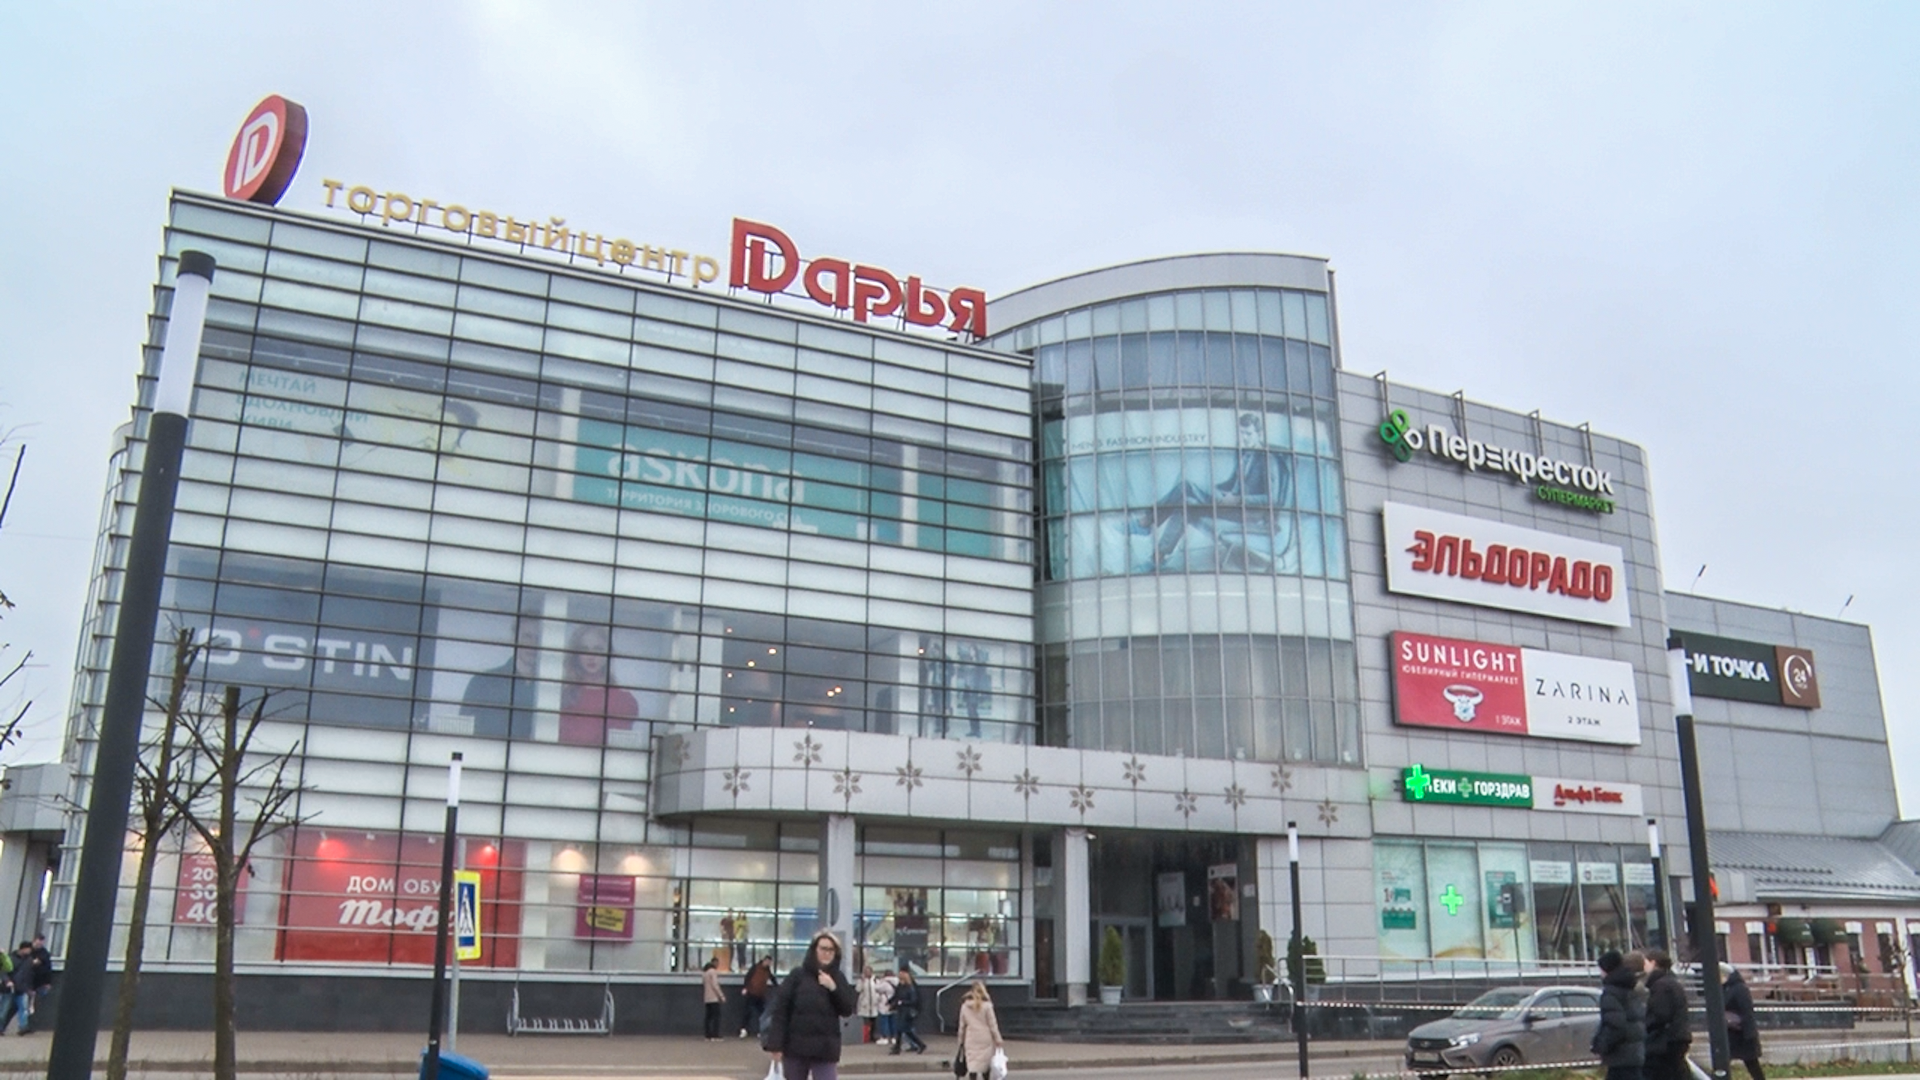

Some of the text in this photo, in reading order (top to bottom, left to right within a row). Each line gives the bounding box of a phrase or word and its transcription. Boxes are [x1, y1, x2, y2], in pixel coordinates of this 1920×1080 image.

[606, 442, 806, 504] askona
[1427, 424, 1614, 494] Перекресток
[1405, 530, 1613, 602] ЭЛЬДОРАДО
[1401, 639, 1517, 673] SUNLIGHT
[1710, 655, 1770, 683] ТОЧКА
[1402, 664, 1519, 685] ЮВЕЛИРНЫЙ ГИПЕРМАРКЕТ
[1793, 668, 1807, 684] 24
[1535, 678, 1630, 706] ZARINA
[1568, 715, 1601, 727] 2 ЭТАЖ
[1474, 781, 1530, 800] ГОРЗДРАВ
[346, 876, 394, 894] ДОМ
